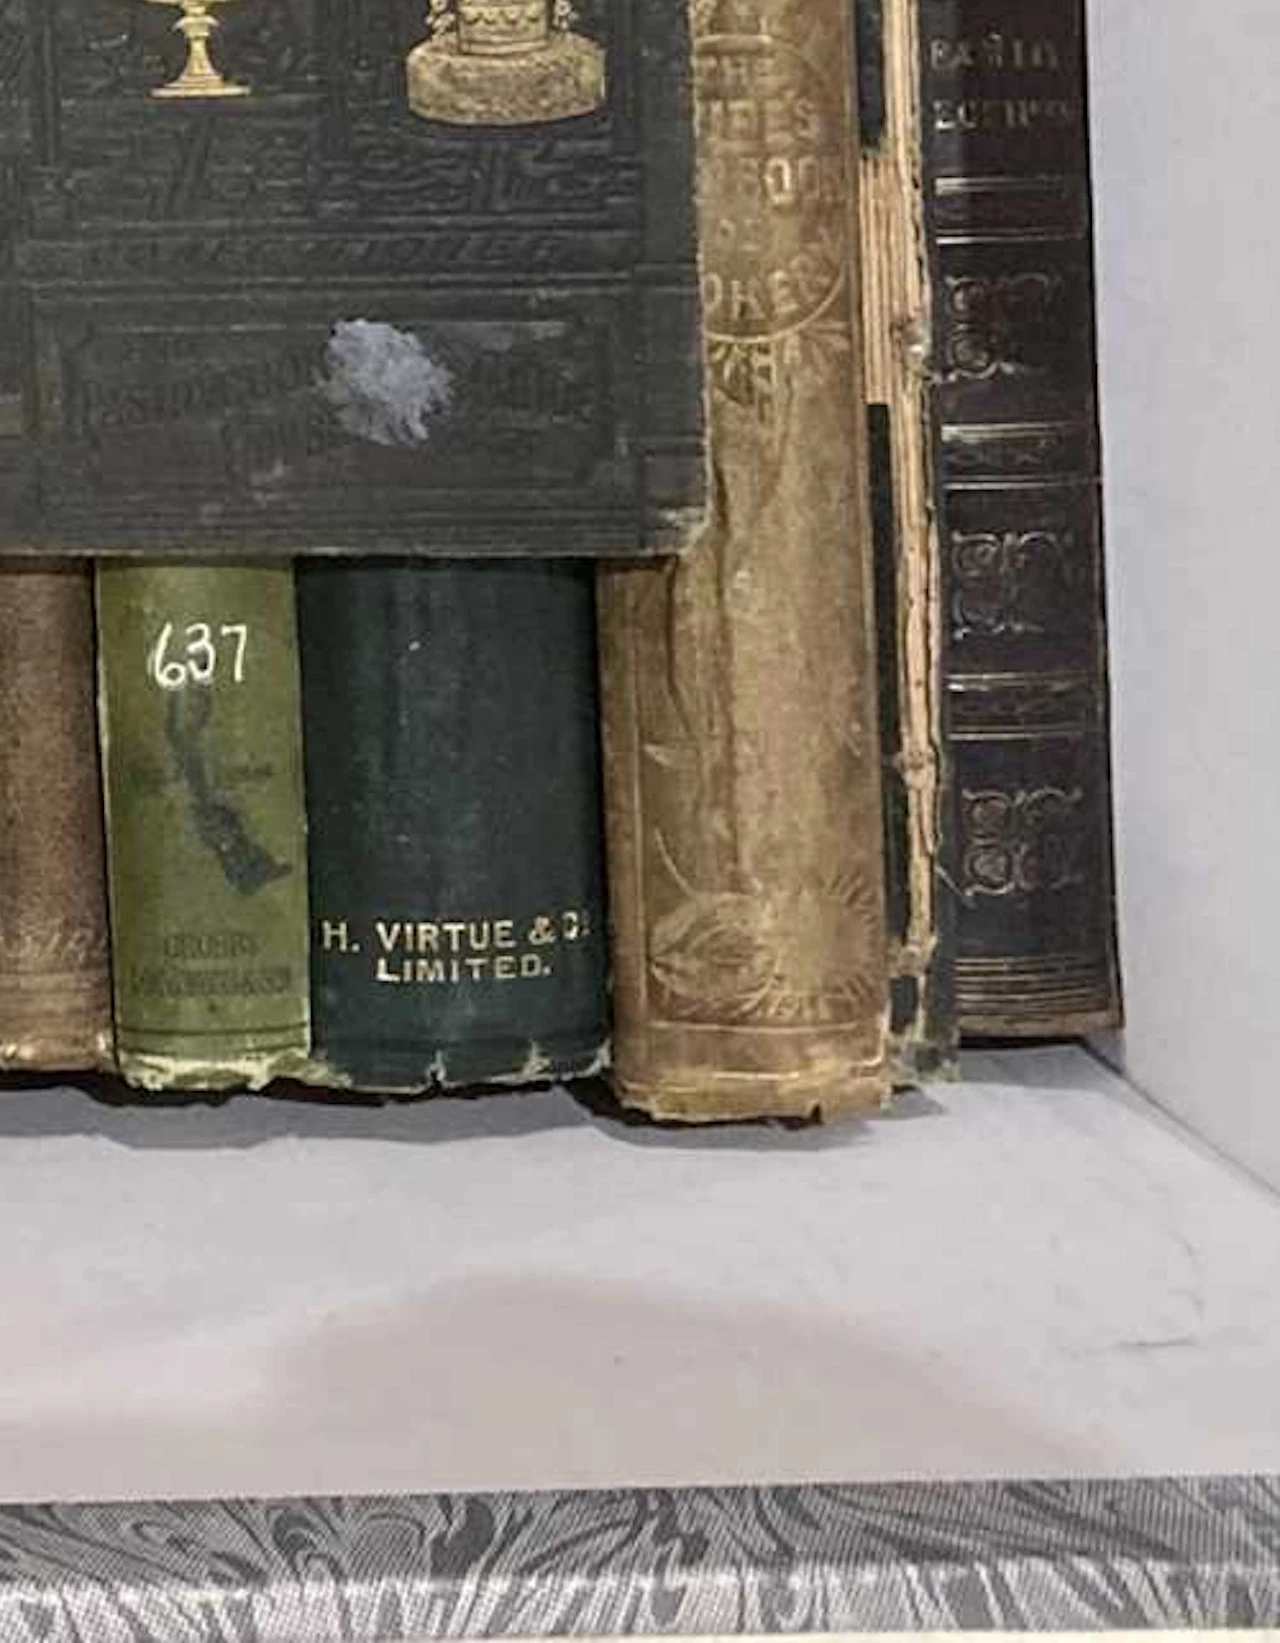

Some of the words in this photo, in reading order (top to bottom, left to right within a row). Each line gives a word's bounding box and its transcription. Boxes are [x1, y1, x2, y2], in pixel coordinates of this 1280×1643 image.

[152, 621, 250, 688] 637
[321, 918, 361, 953] H.
[374, 917, 518, 953] VIRTUE
[528, 914, 557, 946] &
[375, 953, 552, 983] LIMITED.
